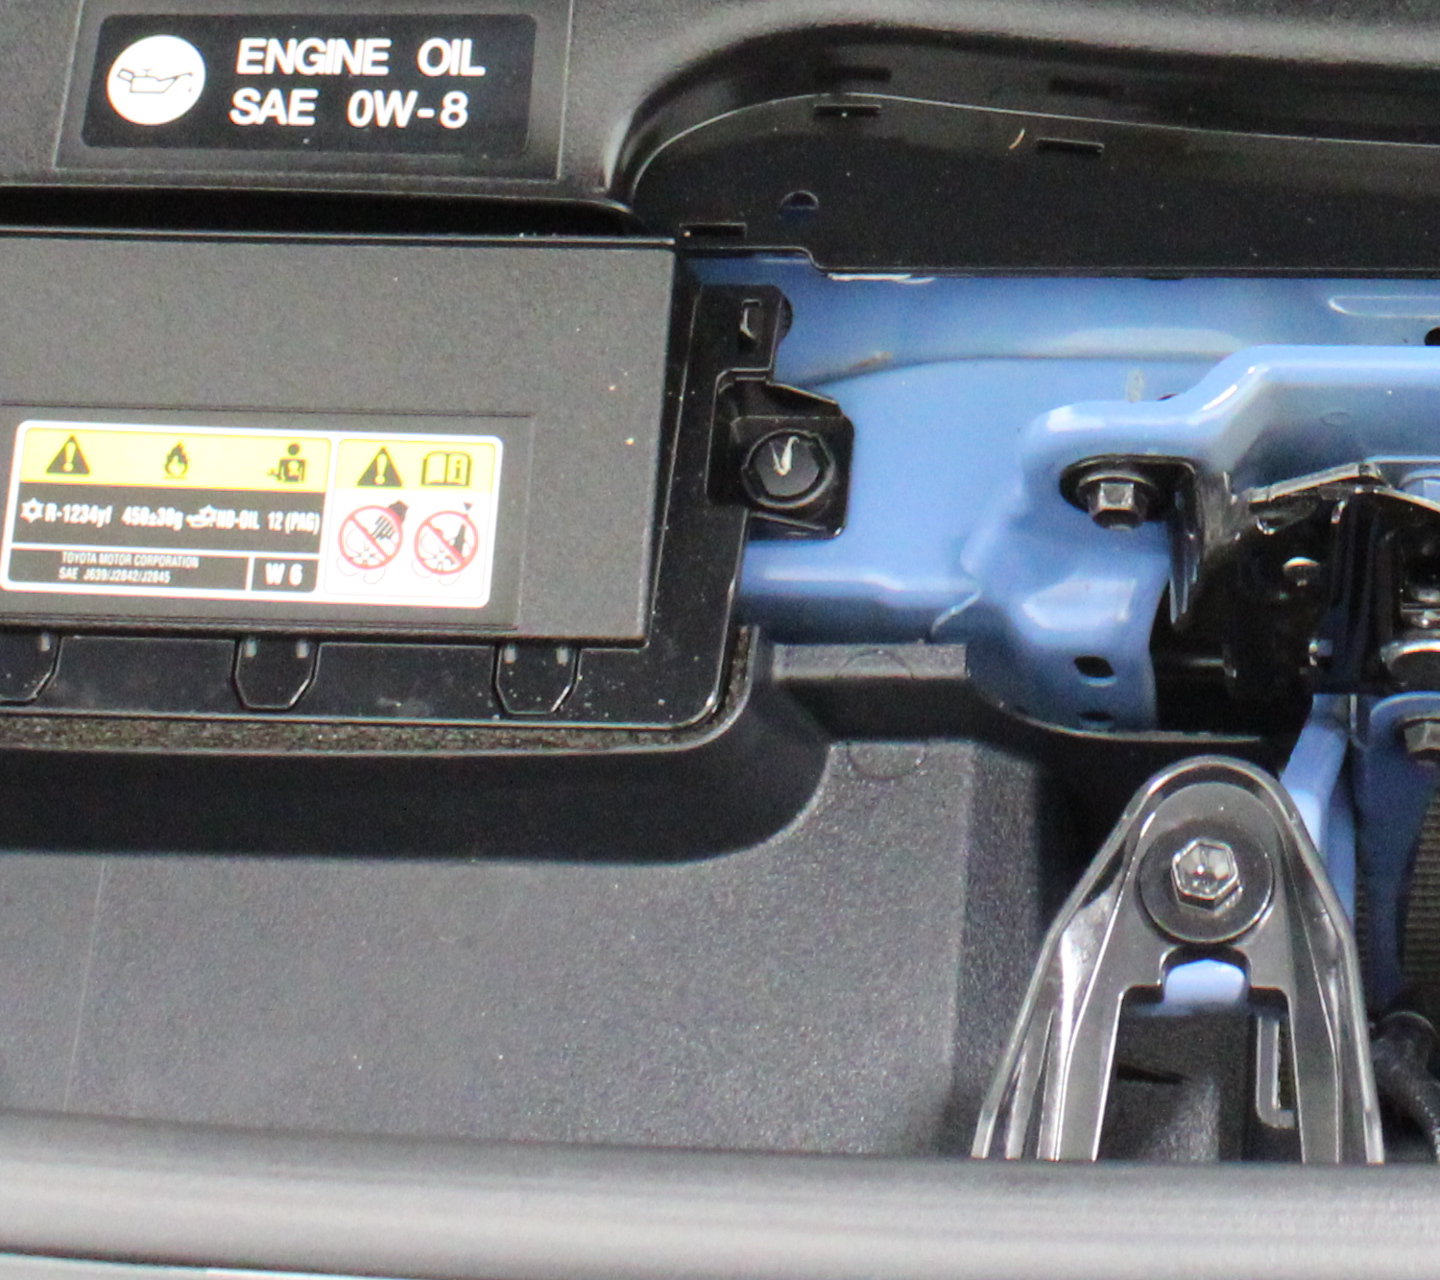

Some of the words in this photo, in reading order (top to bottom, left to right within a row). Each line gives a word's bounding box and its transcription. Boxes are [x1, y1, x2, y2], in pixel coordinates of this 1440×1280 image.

[236, 36, 391, 76] ENGINE
[417, 39, 486, 79] OIL
[229, 87, 320, 126] SAE
[347, 90, 469, 129] 0W-8
[62, 552, 97, 565] TOYOTA
[98, 553, 132, 567] MOTOR
[134, 554, 200, 569] CORPORATION
[58, 567, 78, 581] SAE
[265, 563, 285, 585] W
[289, 564, 304, 586] 6
